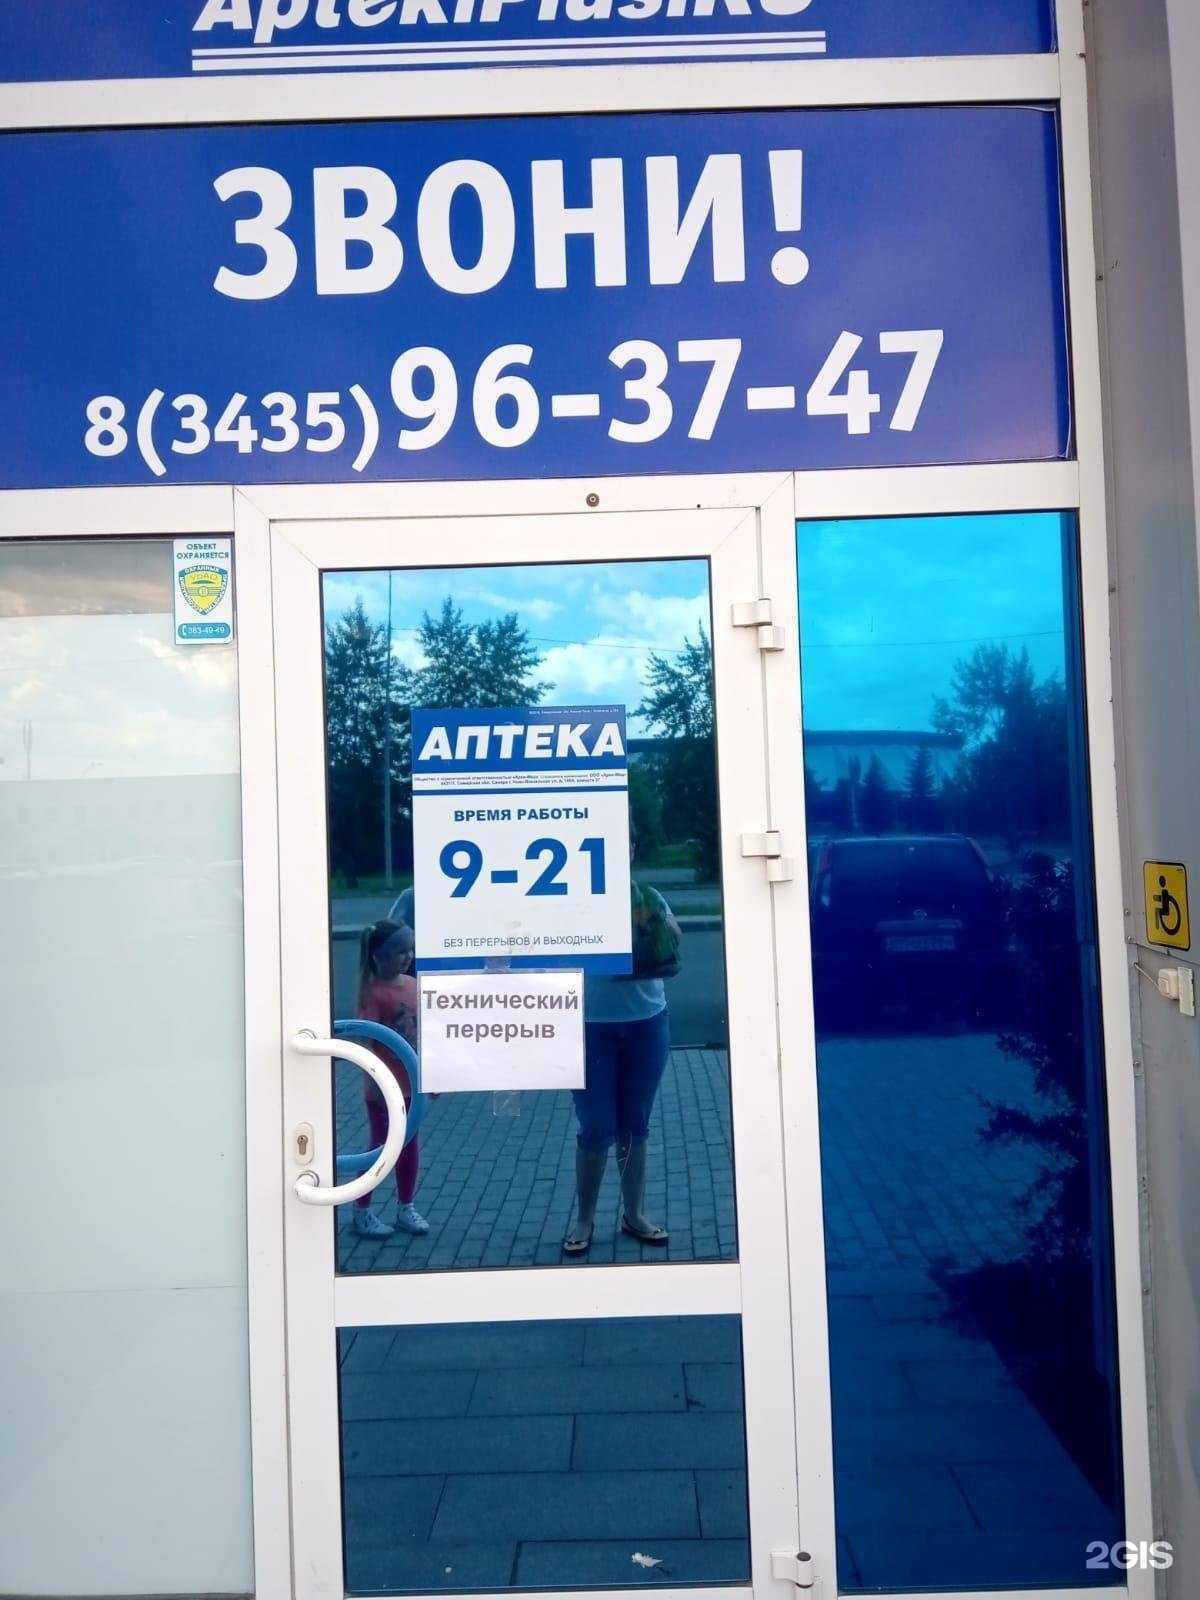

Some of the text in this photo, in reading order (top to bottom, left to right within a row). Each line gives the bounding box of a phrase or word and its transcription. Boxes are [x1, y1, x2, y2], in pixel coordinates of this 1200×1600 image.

[213, 149, 810, 300] ЗВОНИ!
[176, 551, 229, 560] ОХРАНЯЕТСЯ
[186, 543, 217, 551] ОБЪЕКТ
[417, 722, 626, 761] АПТЕКА
[454, 807, 589, 822] ВРЕМЯ РАБОТЫ
[439, 837, 606, 898] 9-21
[443, 934, 604, 948] БЕЗ ПЕРЕРЫВОВ И ВЫХОДНЫХ
[422, 985, 578, 1010] Технический
[446, 1023, 556, 1043] перерыв
